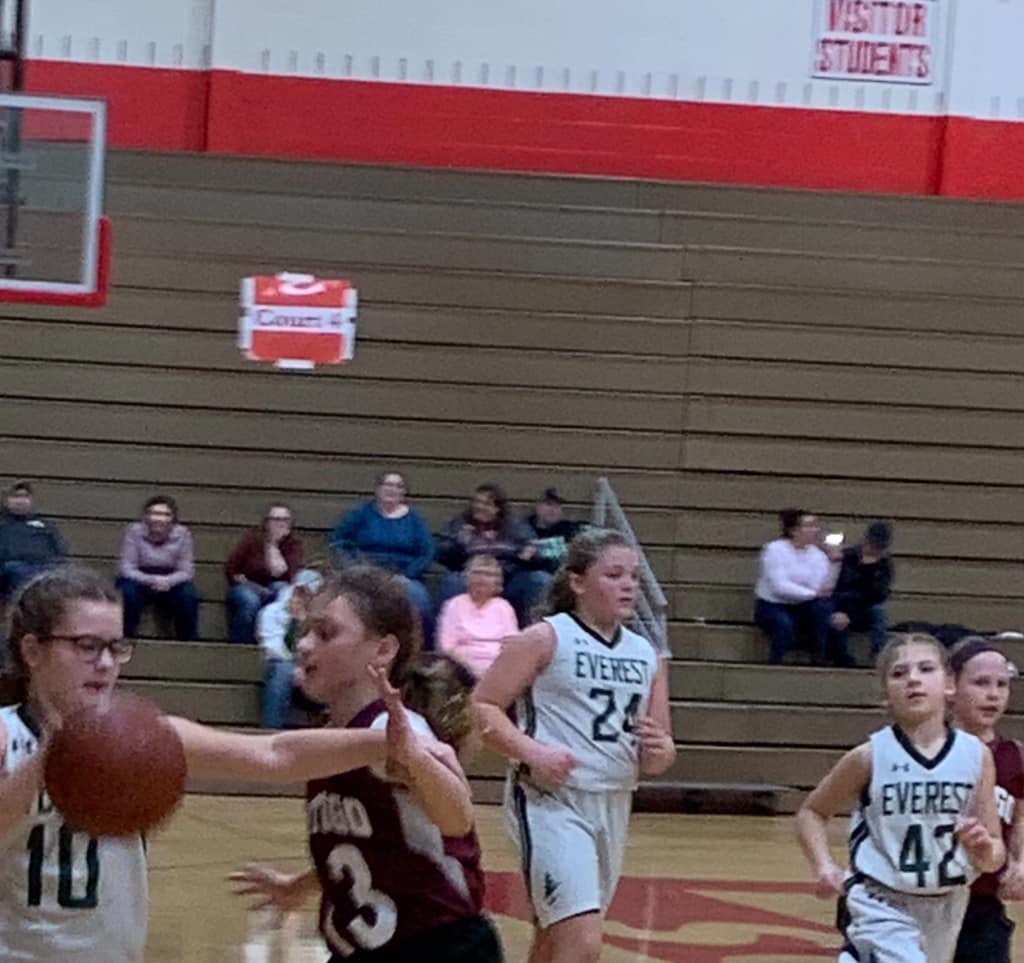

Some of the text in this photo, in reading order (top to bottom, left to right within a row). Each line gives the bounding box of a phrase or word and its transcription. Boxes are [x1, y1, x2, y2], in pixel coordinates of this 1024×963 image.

[816, 38, 930, 78] STUDENTS
[882, 781, 973, 815] EVEREST
[27, 822, 100, 909] 10
[899, 823, 967, 888] 42
